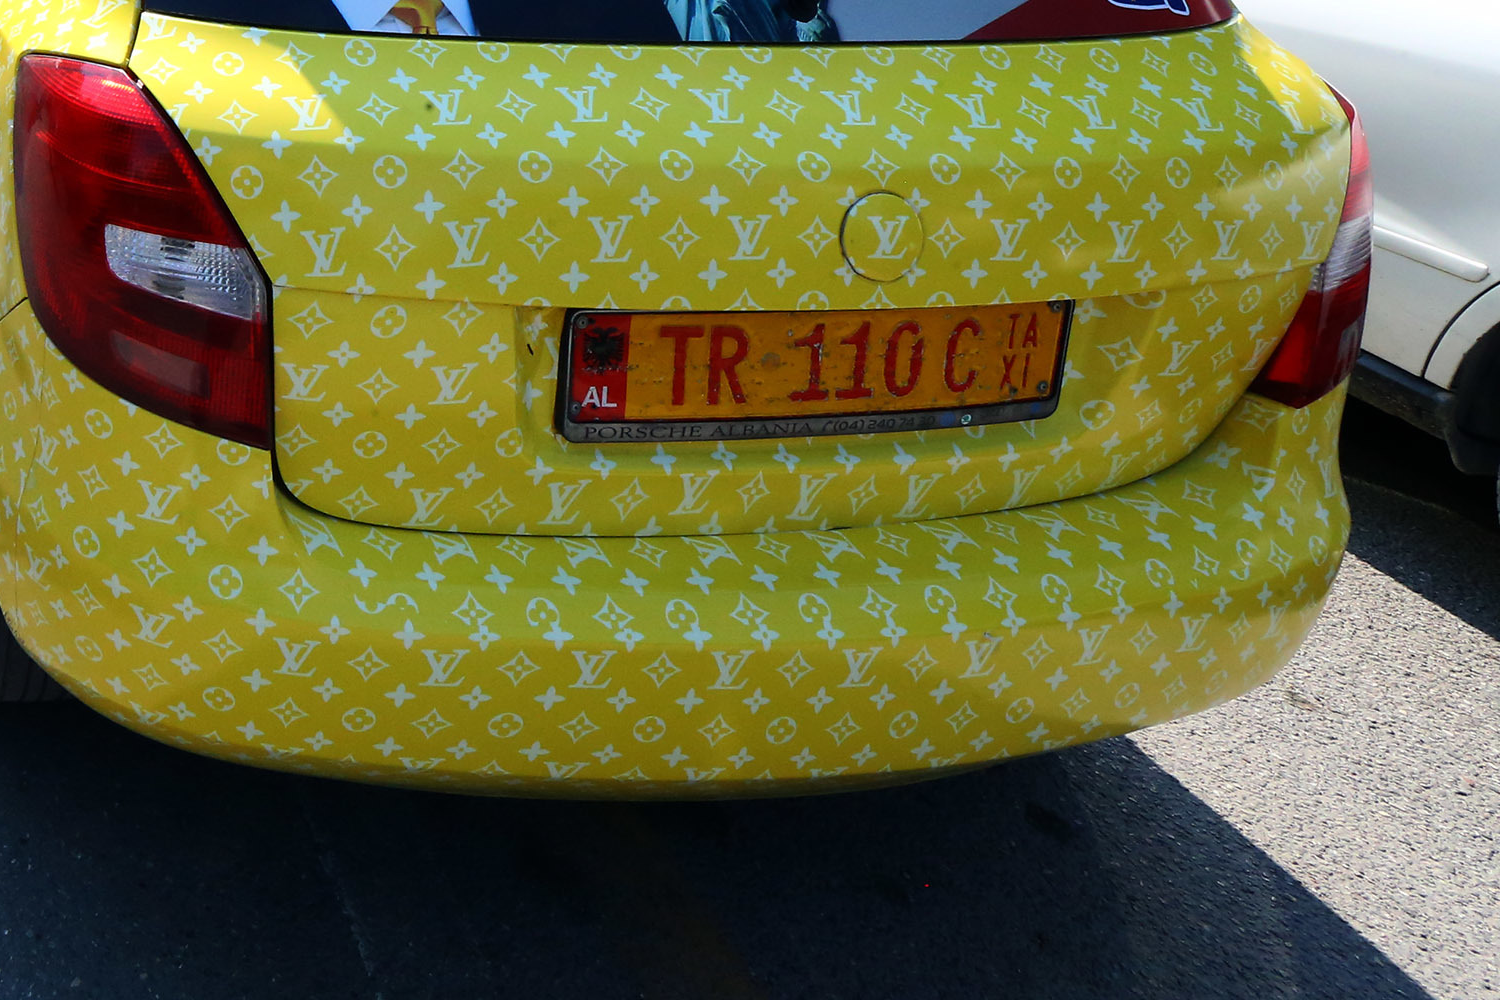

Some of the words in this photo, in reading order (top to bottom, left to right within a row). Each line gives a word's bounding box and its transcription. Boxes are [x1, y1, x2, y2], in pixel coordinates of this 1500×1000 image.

[659, 325, 751, 406] TR
[787, 320, 925, 402] 110
[943, 318, 981, 393] C
[581, 387, 618, 409] AL
[584, 422, 703, 441] PORSCHE
[710, 421, 815, 438] ALBANIA
